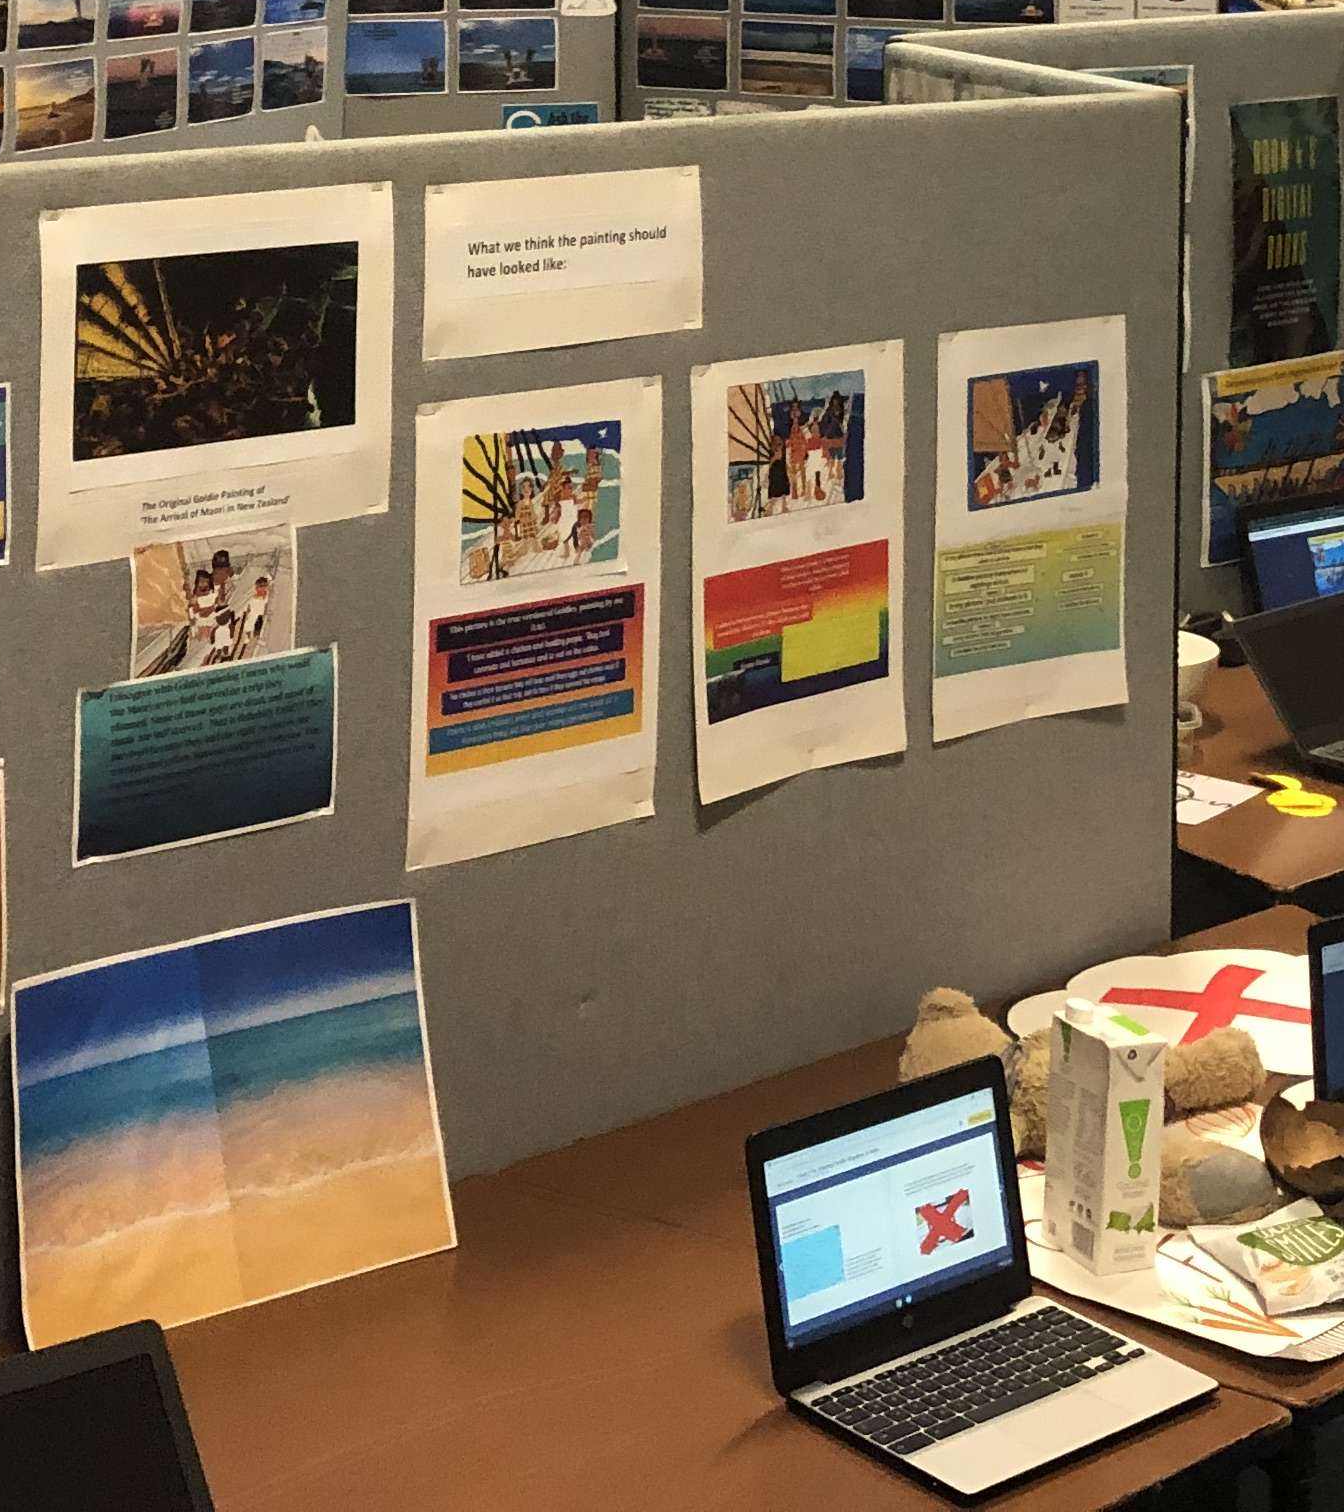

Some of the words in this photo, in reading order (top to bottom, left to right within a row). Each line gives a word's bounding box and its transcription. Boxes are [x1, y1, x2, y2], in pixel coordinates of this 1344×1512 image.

[1263, 184, 1312, 222] DIGITAL
[468, 241, 500, 255] What
[504, 242, 521, 252] we
[525, 235, 554, 250] think
[558, 235, 576, 247] the
[580, 231, 626, 249] painting
[629, 225, 667, 241] should
[1267, 230, 1307, 270] BOOKS
[467, 265, 496, 278] have
[500, 260, 539, 275] looked
[543, 257, 567, 271] like:
[143, 502, 156, 511] The
[159, 496, 191, 509] Original
[194, 493, 219, 503] Goldie
[221, 488, 254, 499] Painting
[257, 485, 265, 494] of
[160, 511, 188, 522] Arrival
[190, 509, 199, 518] of
[200, 506, 224, 516] Maori
[227, 504, 235, 512] in
[237, 503, 255, 511] New
